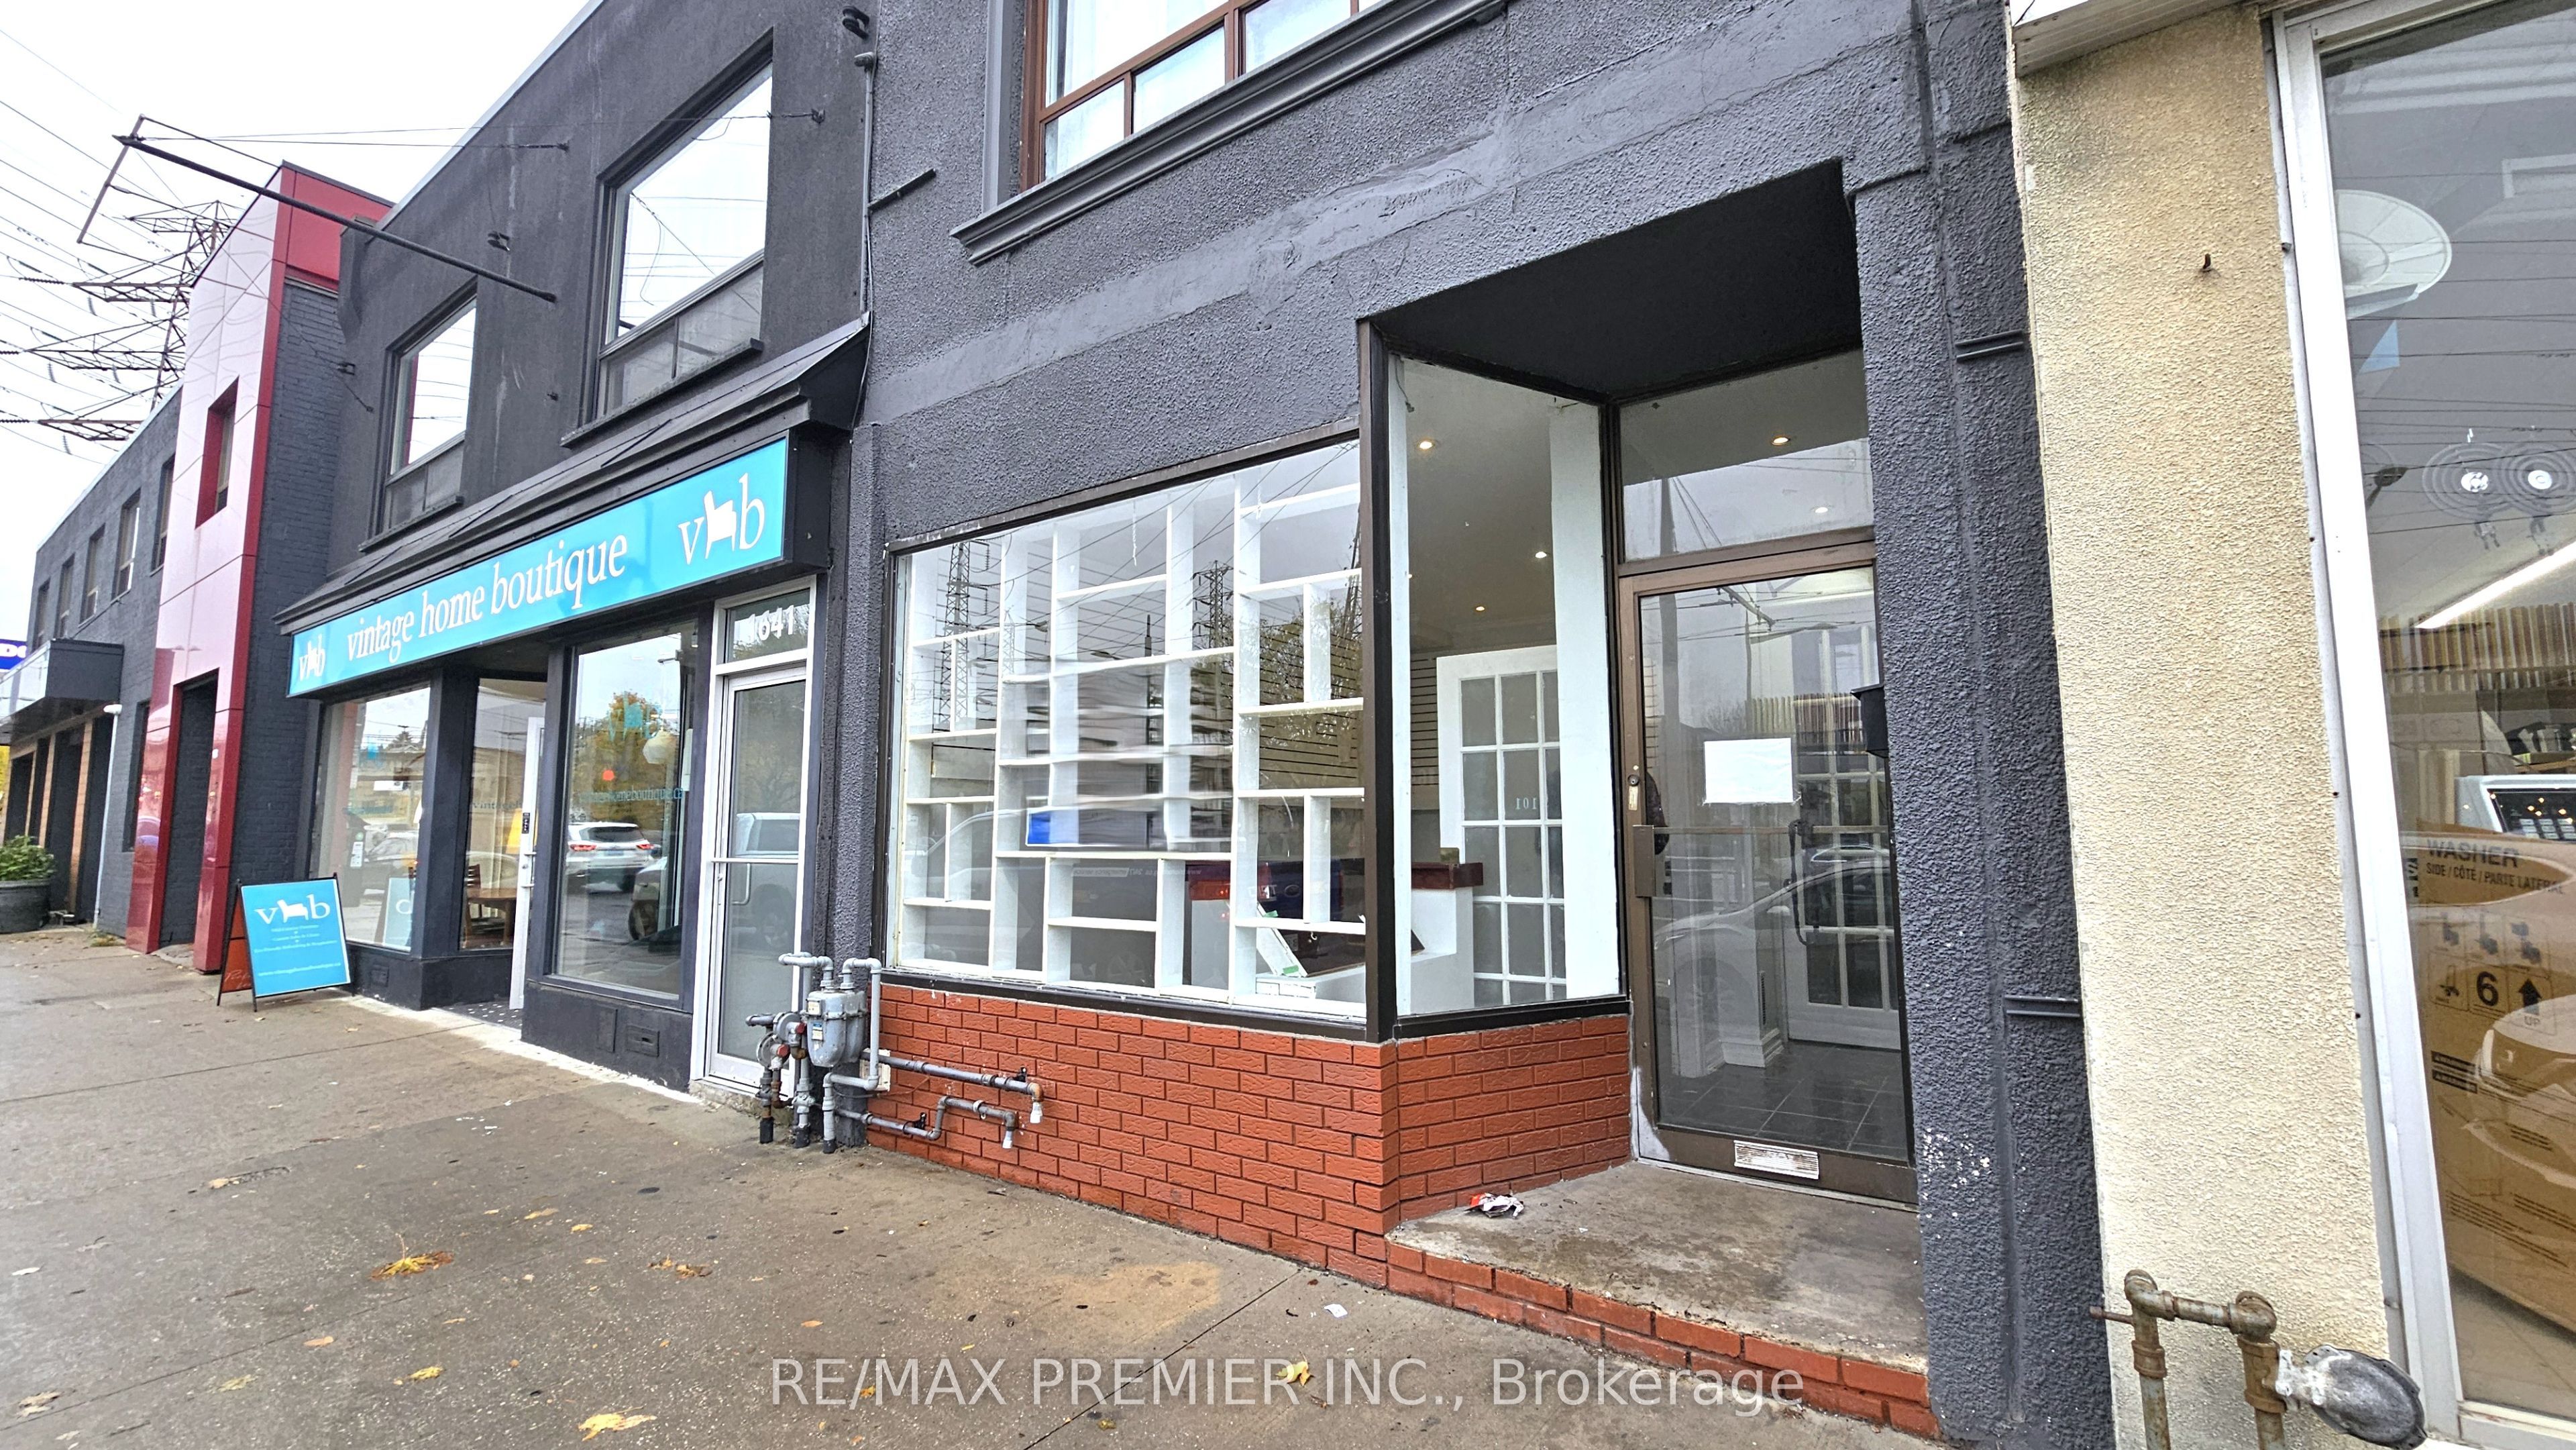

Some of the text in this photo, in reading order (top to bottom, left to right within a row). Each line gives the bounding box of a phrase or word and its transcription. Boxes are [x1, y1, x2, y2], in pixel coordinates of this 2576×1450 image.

[347, 535, 628, 663] vintage home boutique
[747, 605, 794, 642] 1641
[1515, 797, 1537, 810] 101
[2427, 839, 2520, 868] WASHER
[2426, 862, 2446, 877] SIDE
[2453, 863, 2477, 881] CÔTÉ
[2484, 872, 2515, 888] PARTE
[2476, 971, 2499, 1006] 6
[2524, 1015, 2541, 1027] UP
